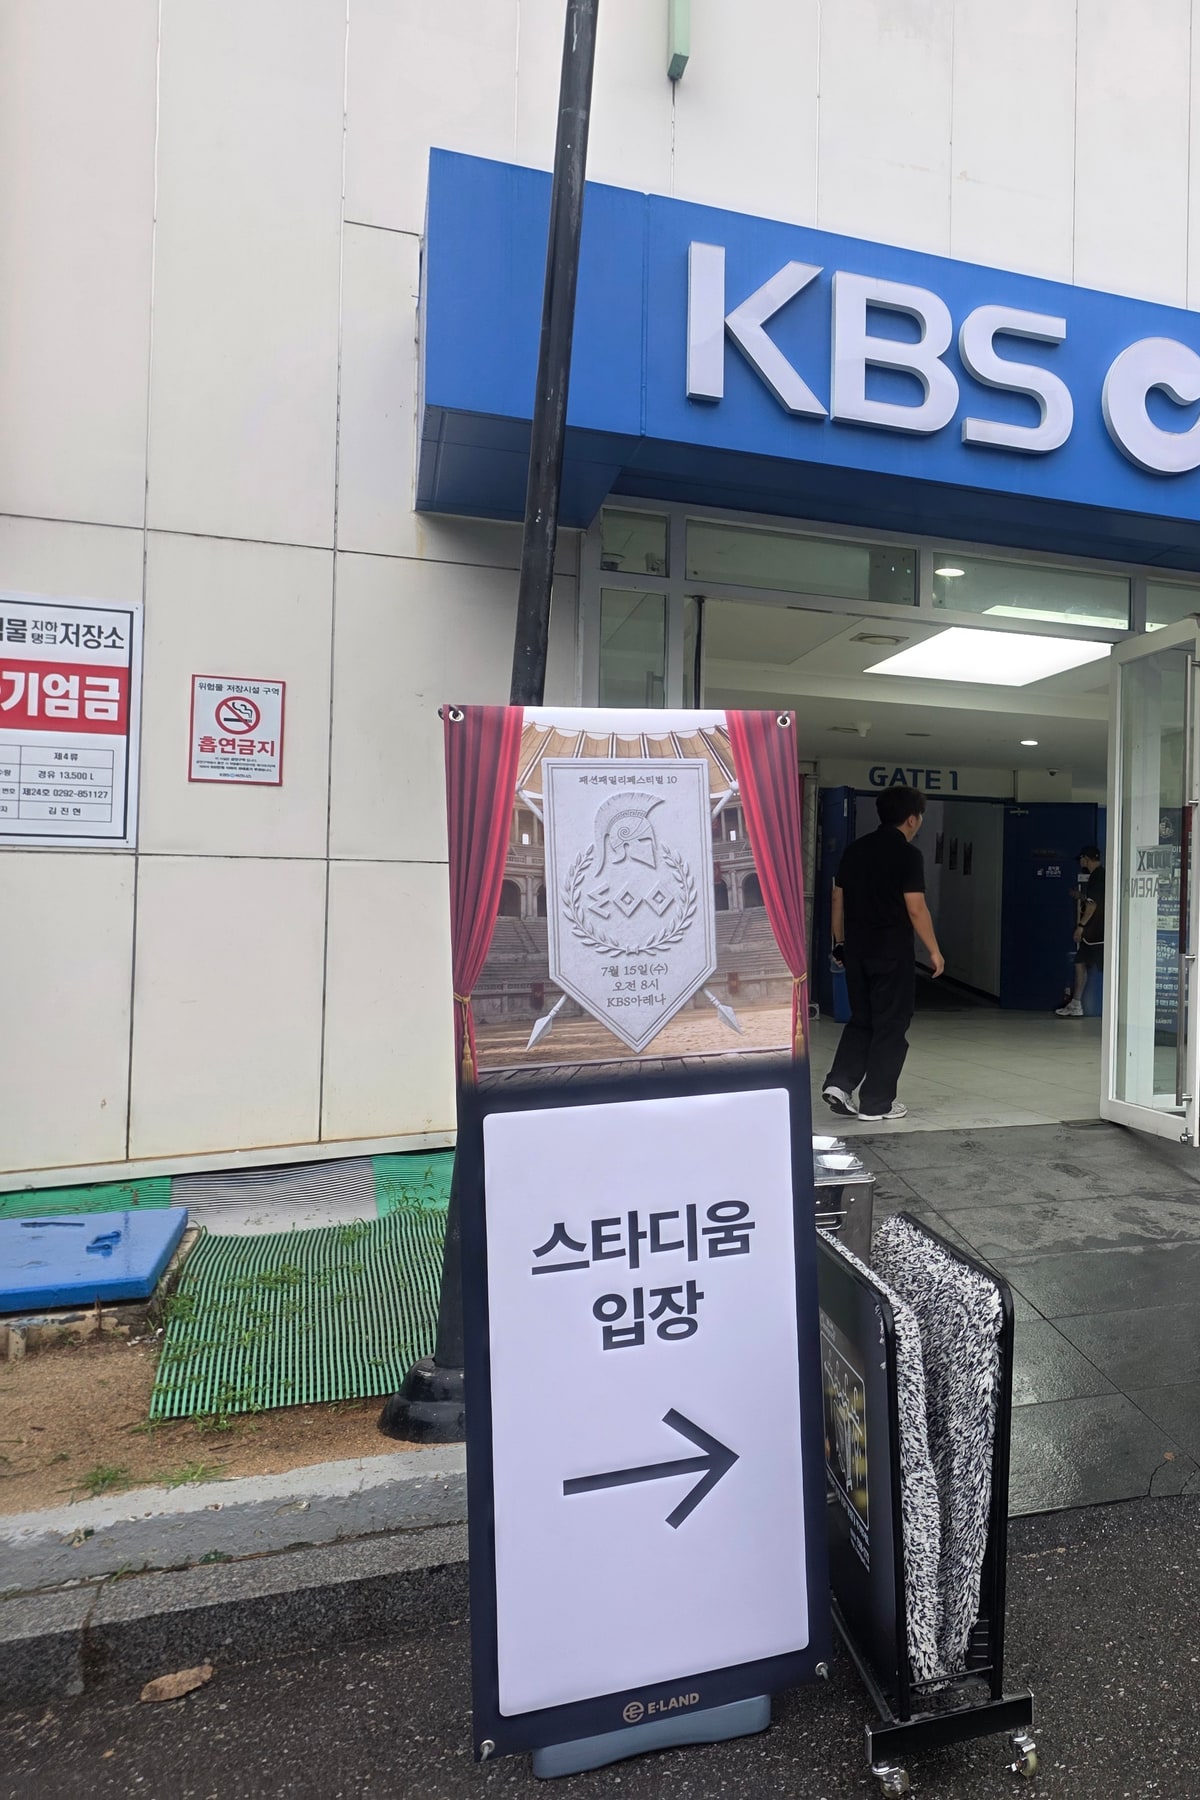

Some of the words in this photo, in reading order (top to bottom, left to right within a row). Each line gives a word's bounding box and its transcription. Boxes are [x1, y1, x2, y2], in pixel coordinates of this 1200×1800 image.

[687, 241, 1074, 455] KBS
[31, 620, 58, 632] 지하
[59, 622, 124, 649] 저장소
[0, 671, 120, 721] 기엄금
[197, 735, 275, 757] 흡연금지
[869, 766, 942, 790] GATE
[949, 770, 958, 791] 1
[601, 965, 619, 977] 7월
[612, 980, 636, 991] 오전
[641, 978, 659, 991] 8시
[531, 1200, 756, 1275] 스타디움
[592, 1279, 705, 1351] 입장
